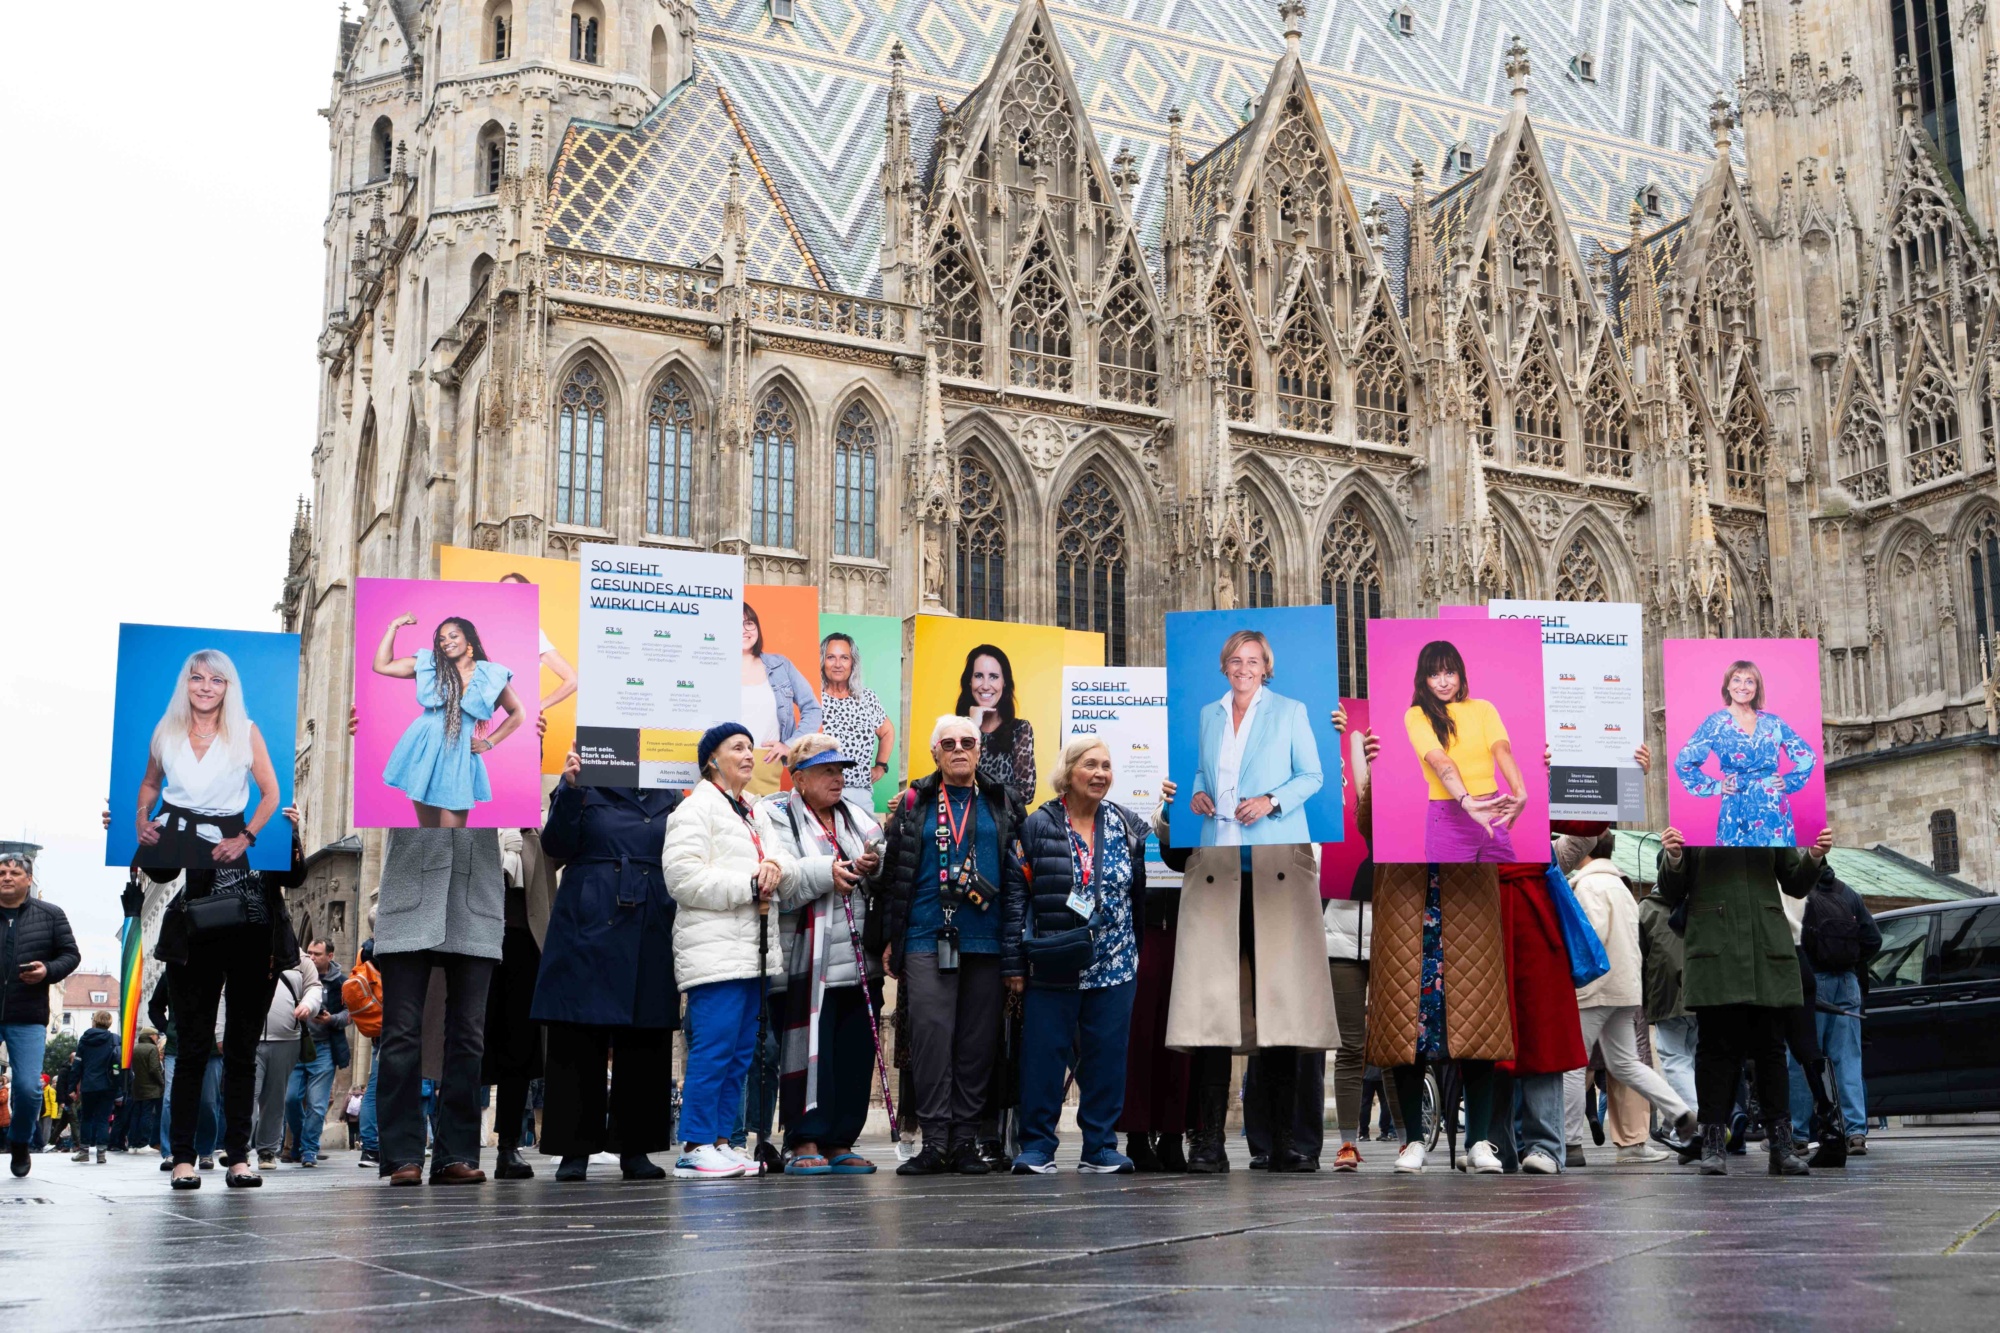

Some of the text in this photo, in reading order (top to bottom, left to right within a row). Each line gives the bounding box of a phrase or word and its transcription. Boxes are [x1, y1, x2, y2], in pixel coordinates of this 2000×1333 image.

[592, 560, 659, 576] SO SIEHT
[591, 578, 733, 599] GESUNDES ALTERN
[591, 596, 699, 615] WIRKLICH AUS
[1541, 633, 1628, 645] HTBARKEIT
[1072, 682, 1127, 691] SO SIEHT
[1072, 696, 1167, 706] GESELLSCHAFT
[1072, 710, 1116, 720] DRUCK
[1072, 724, 1097, 733] AUS
